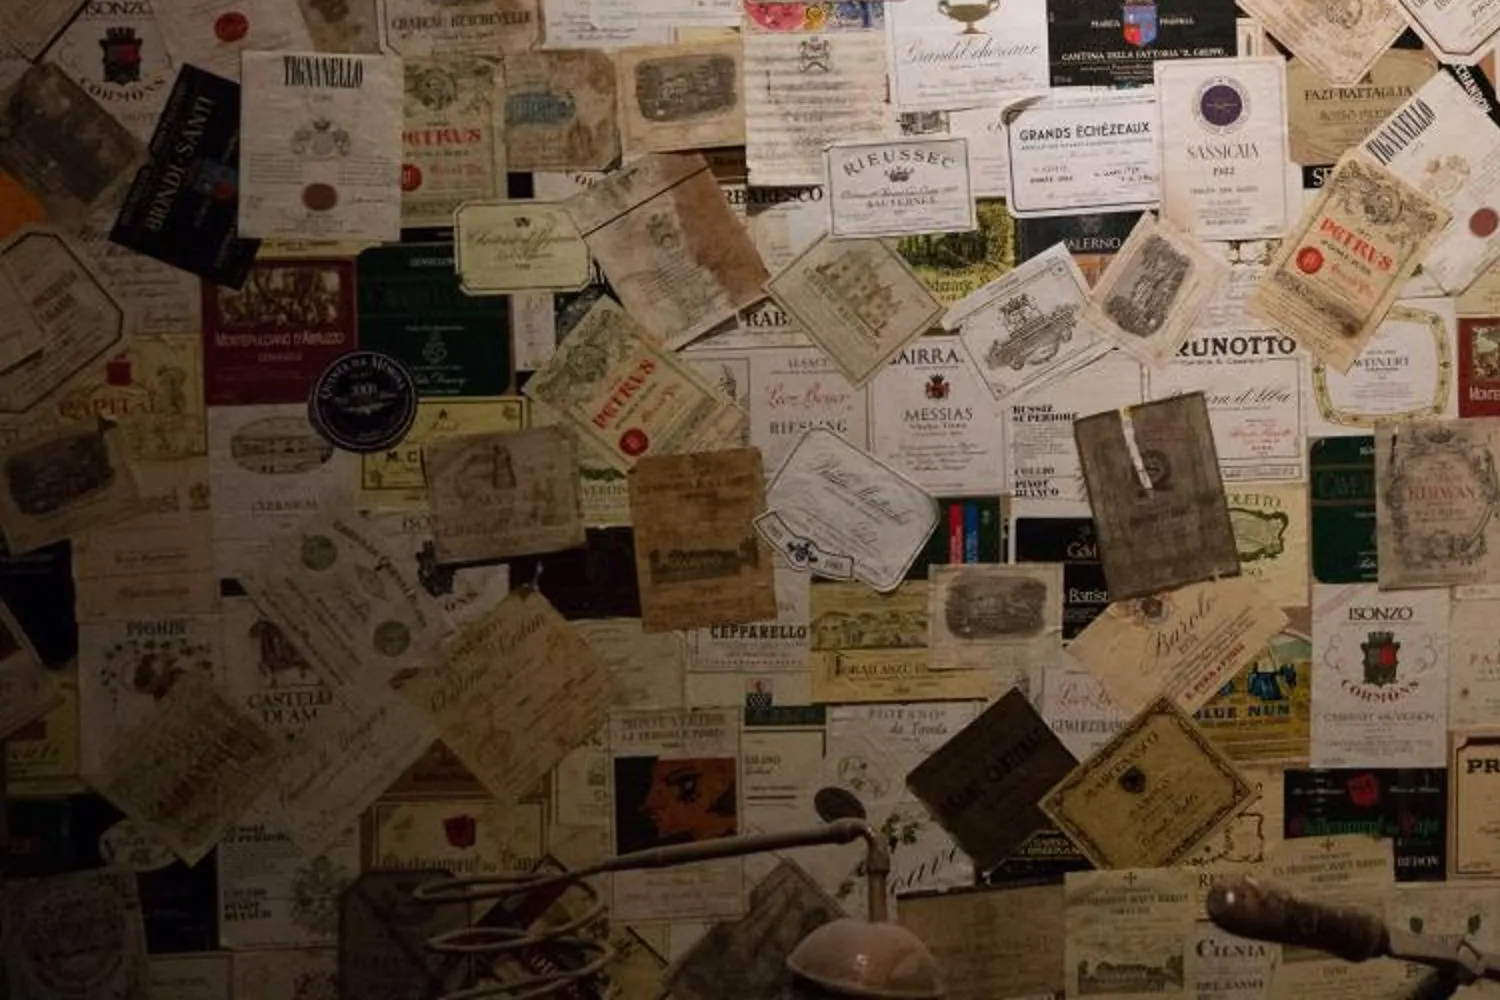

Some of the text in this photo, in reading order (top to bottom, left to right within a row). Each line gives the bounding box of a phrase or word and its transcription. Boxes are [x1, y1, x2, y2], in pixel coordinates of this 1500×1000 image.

[1018, 126, 1071, 143] GRANDS
[1185, 145, 1260, 161] SASSICAIA
[842, 148, 955, 179] RIEUSSEC
[1064, 238, 1122, 250] ALERNO
[888, 346, 964, 366] AIRRA
[904, 406, 974, 422] MESSIAS
[1347, 605, 1414, 622] ISONZO
